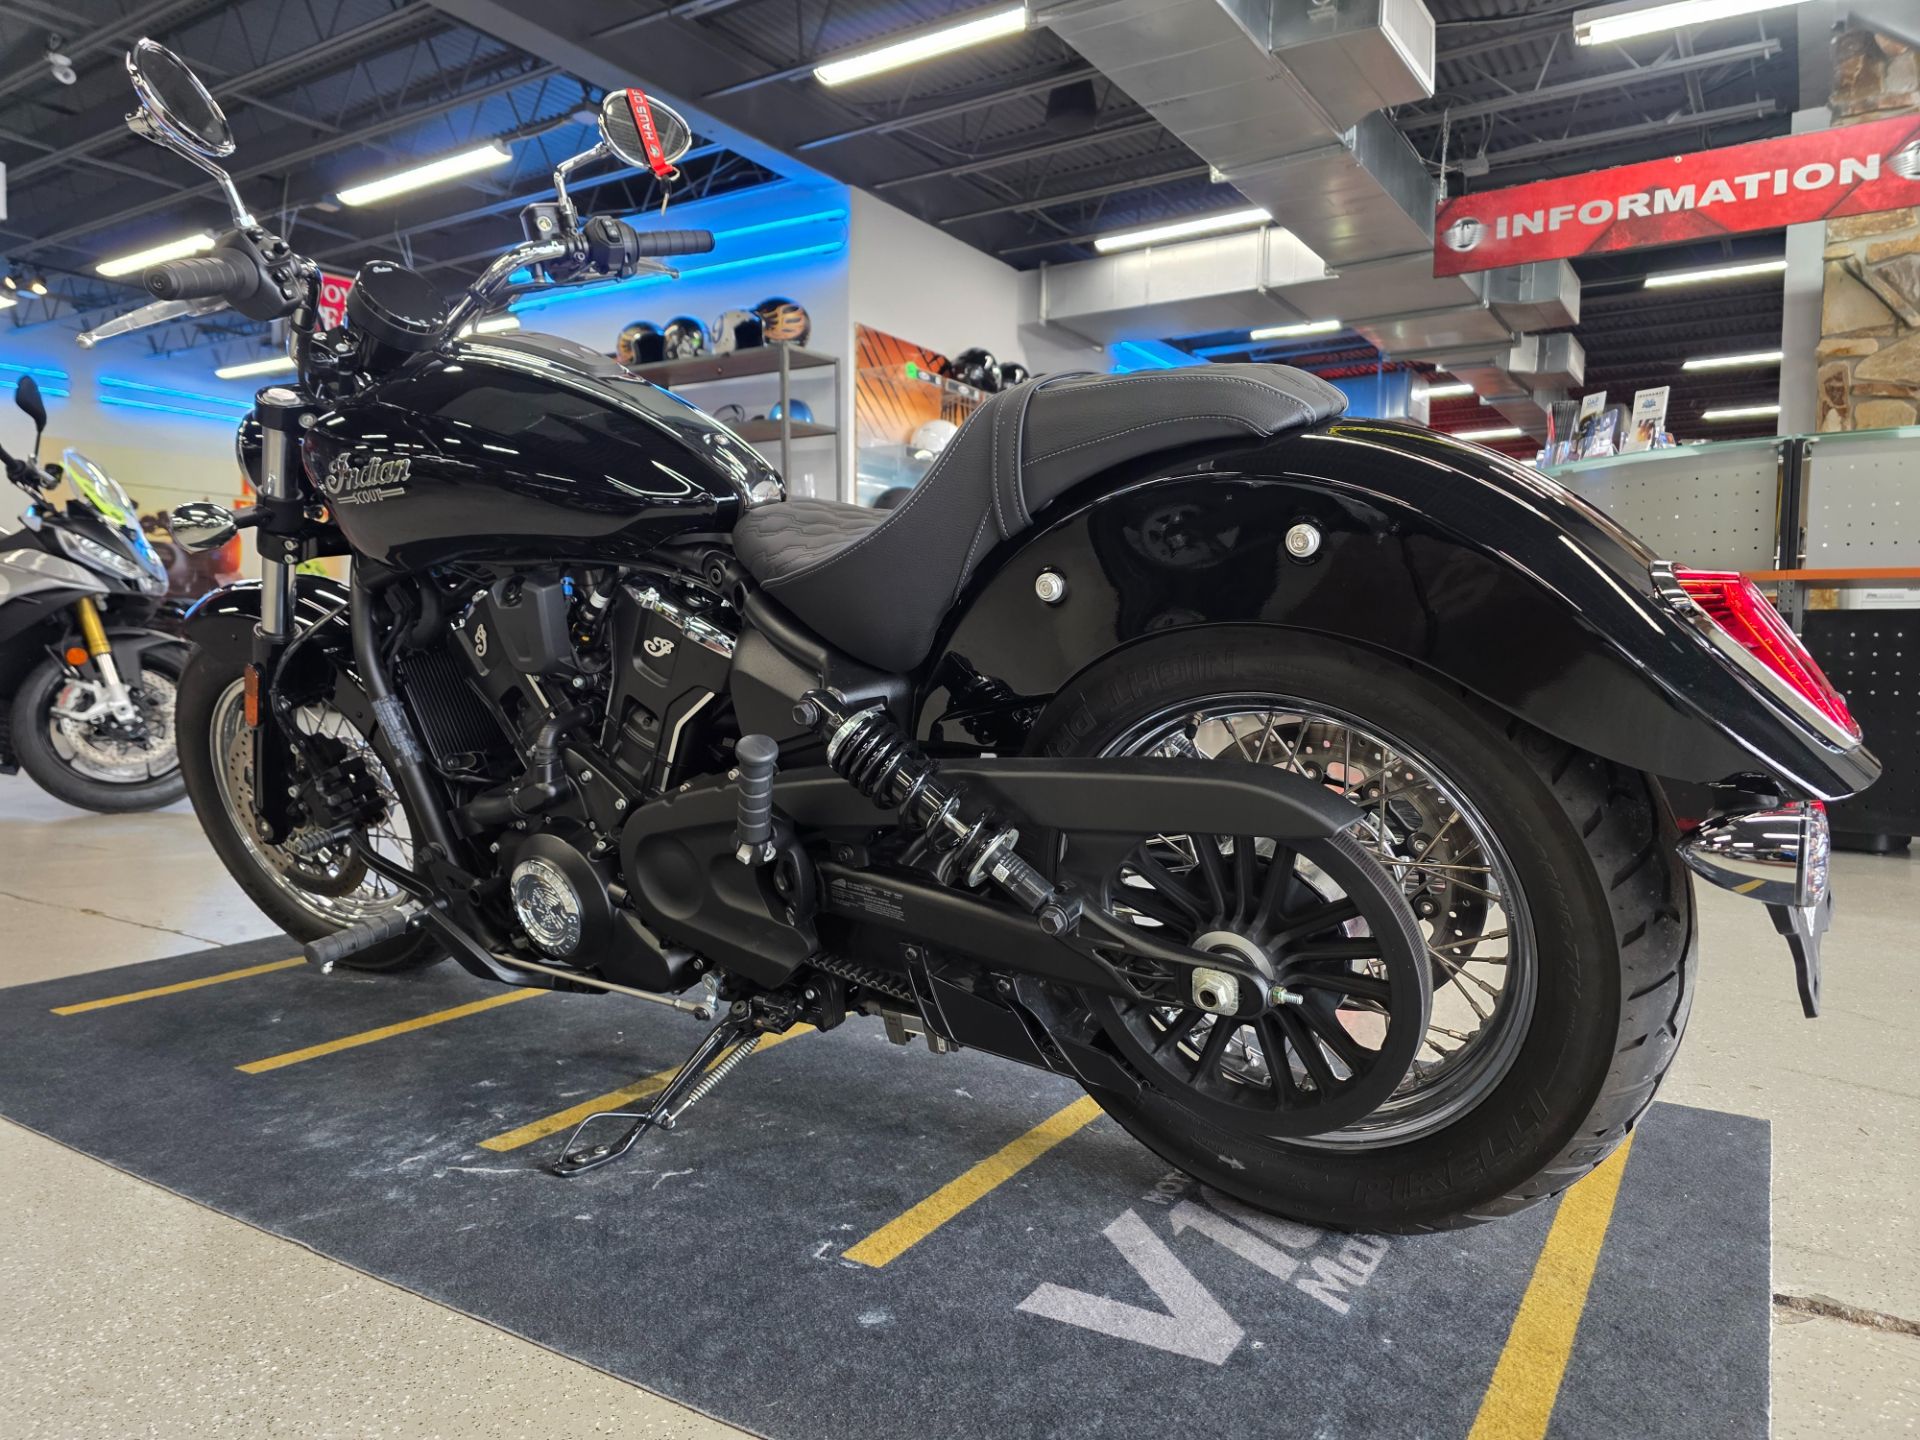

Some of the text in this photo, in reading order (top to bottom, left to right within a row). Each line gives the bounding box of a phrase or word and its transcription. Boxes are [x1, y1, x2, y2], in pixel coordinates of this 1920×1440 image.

[636, 105, 655, 140] HAUS
[1495, 153, 1881, 240] INFORMATION
[325, 453, 412, 494] Indian
[353, 488, 384, 504] SCOUT
